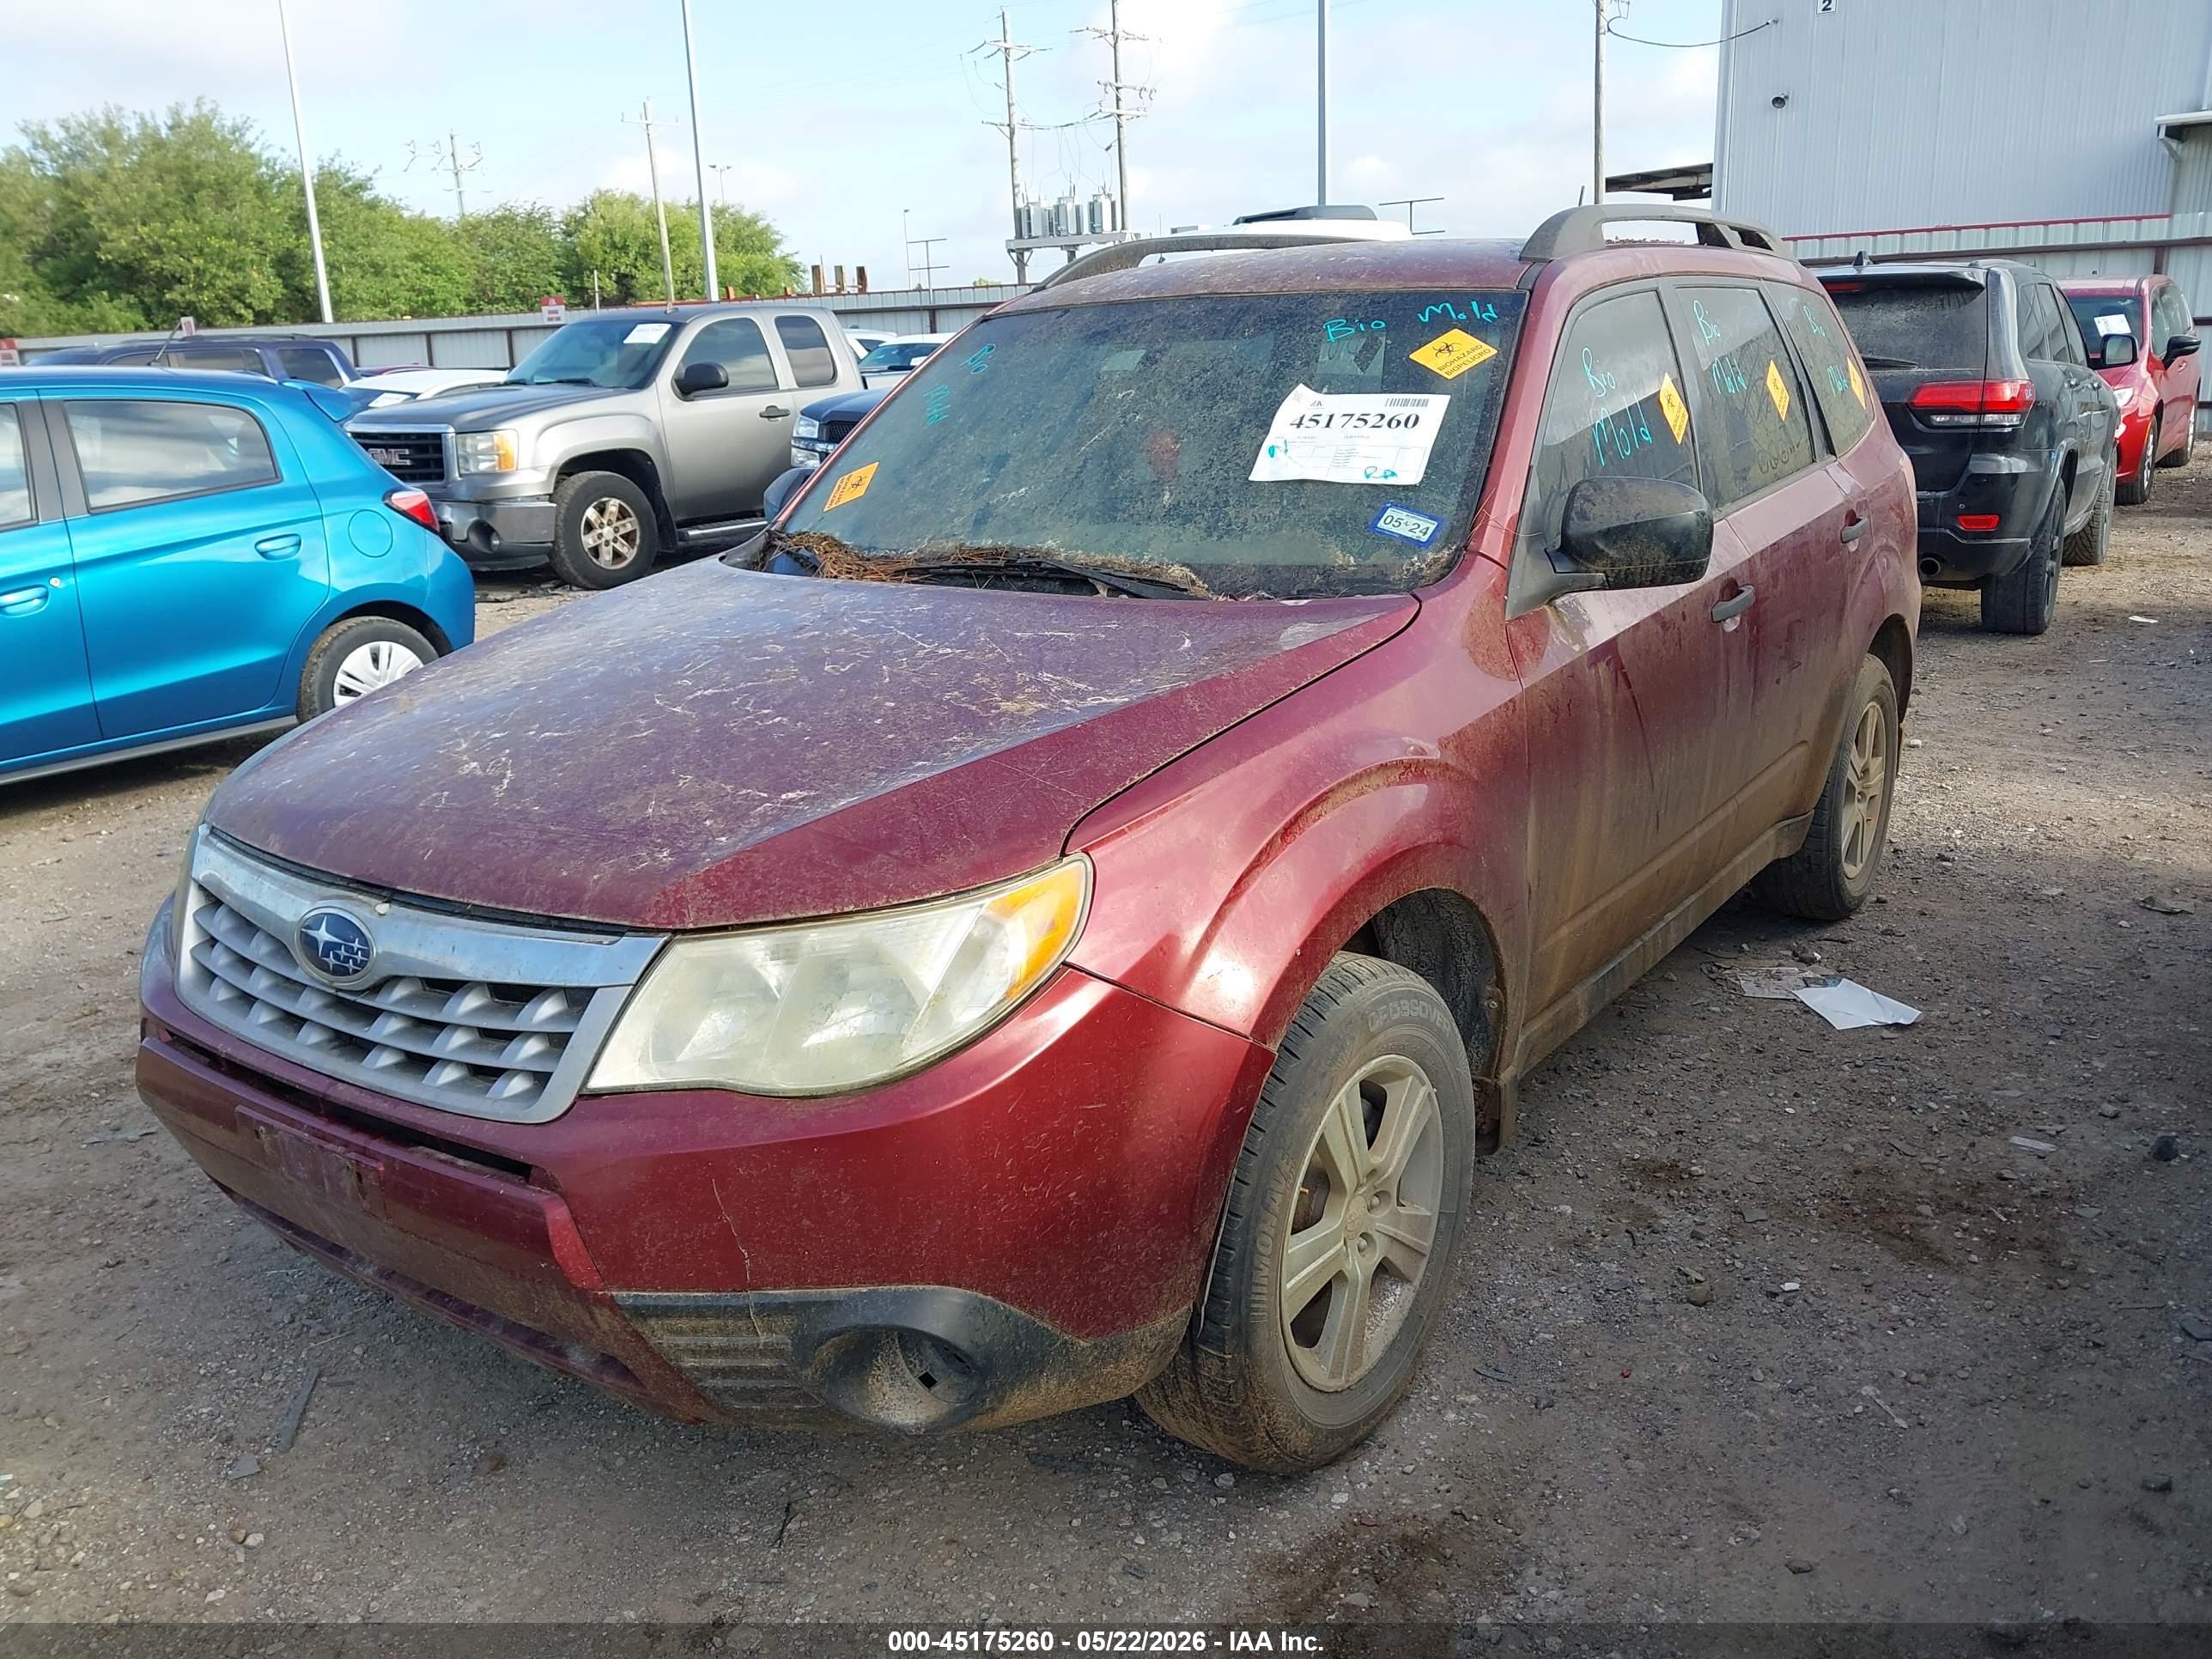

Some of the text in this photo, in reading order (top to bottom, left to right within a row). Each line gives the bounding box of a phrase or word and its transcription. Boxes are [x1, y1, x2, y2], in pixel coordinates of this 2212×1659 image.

[1821, 0, 1832, 12] 2
[1322, 319, 1388, 343] Bio
[1437, 344, 1482, 371] BIOHAZARD
[1444, 349, 1491, 376] BIOPELIGRO
[1582, 347, 1616, 398] Bio
[1291, 413, 1420, 429] 45175260
[368, 448, 410, 465] GMC
